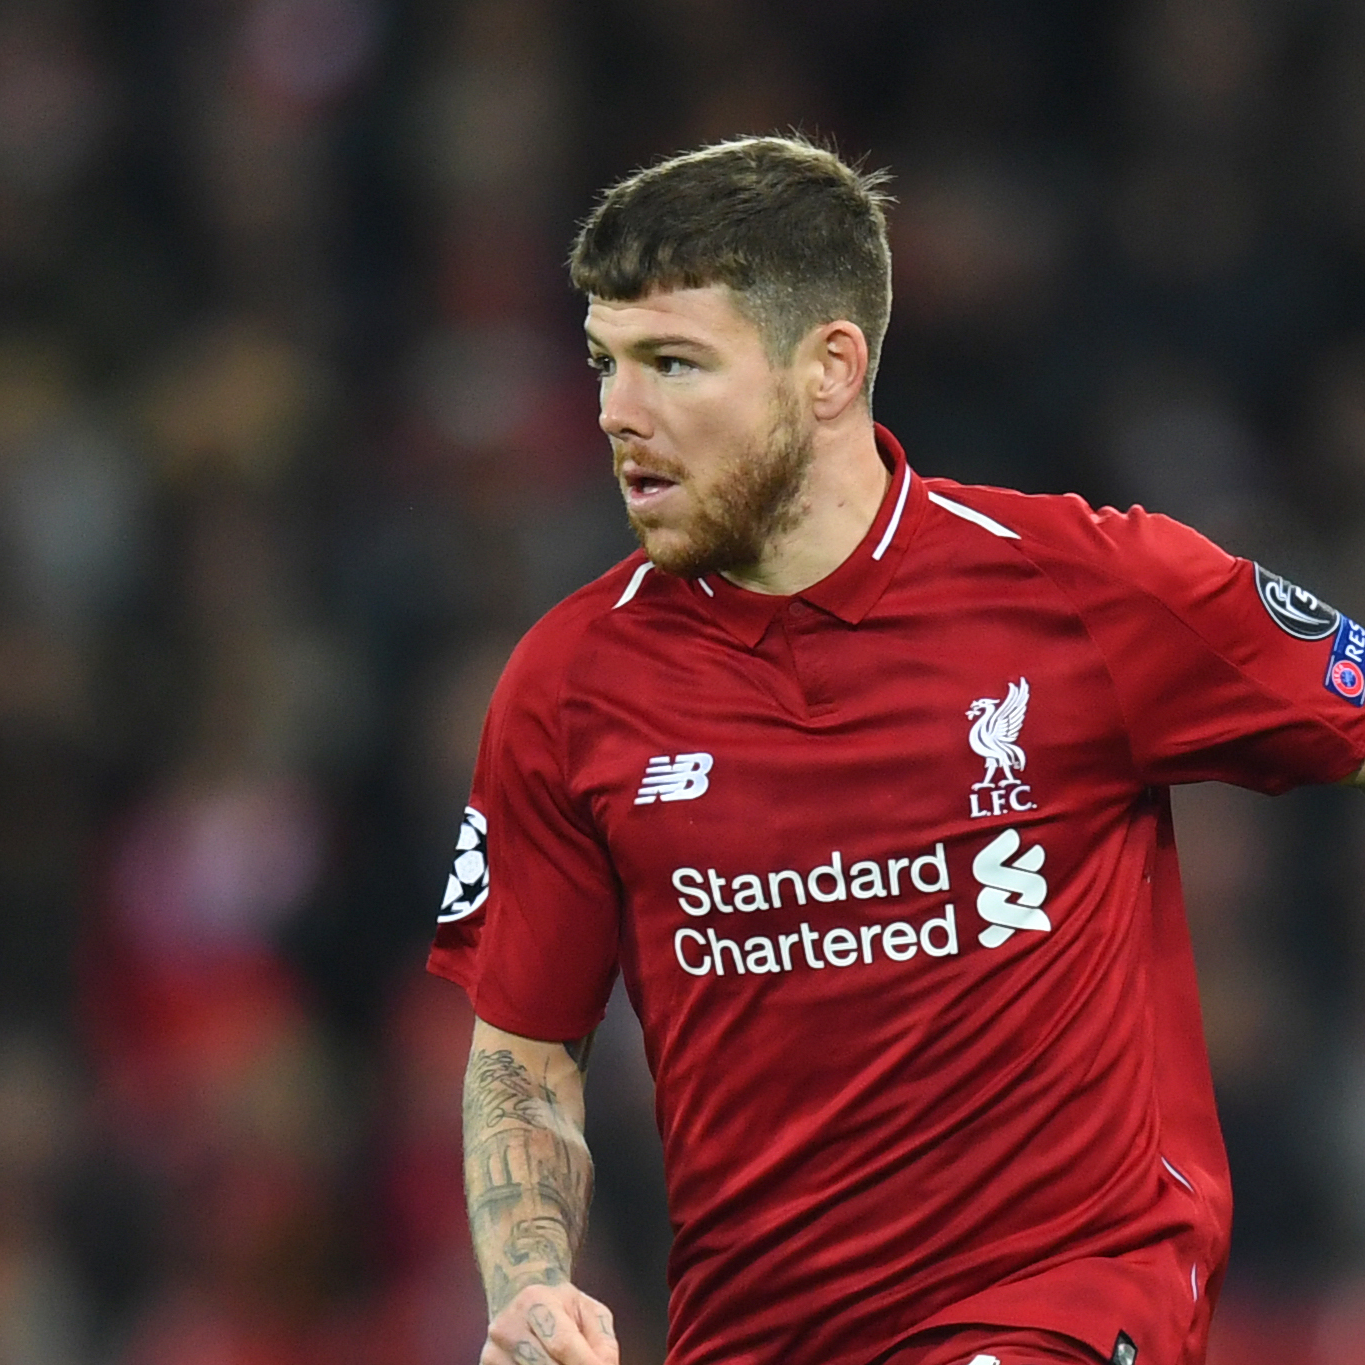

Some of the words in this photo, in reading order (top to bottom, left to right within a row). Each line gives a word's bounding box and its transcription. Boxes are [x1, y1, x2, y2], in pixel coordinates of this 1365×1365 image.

[634, 752, 714, 804] NB
[970, 784, 1037, 817] L.F.C.
[671, 842, 951, 916] Standard
[674, 904, 960, 976] Chartered
